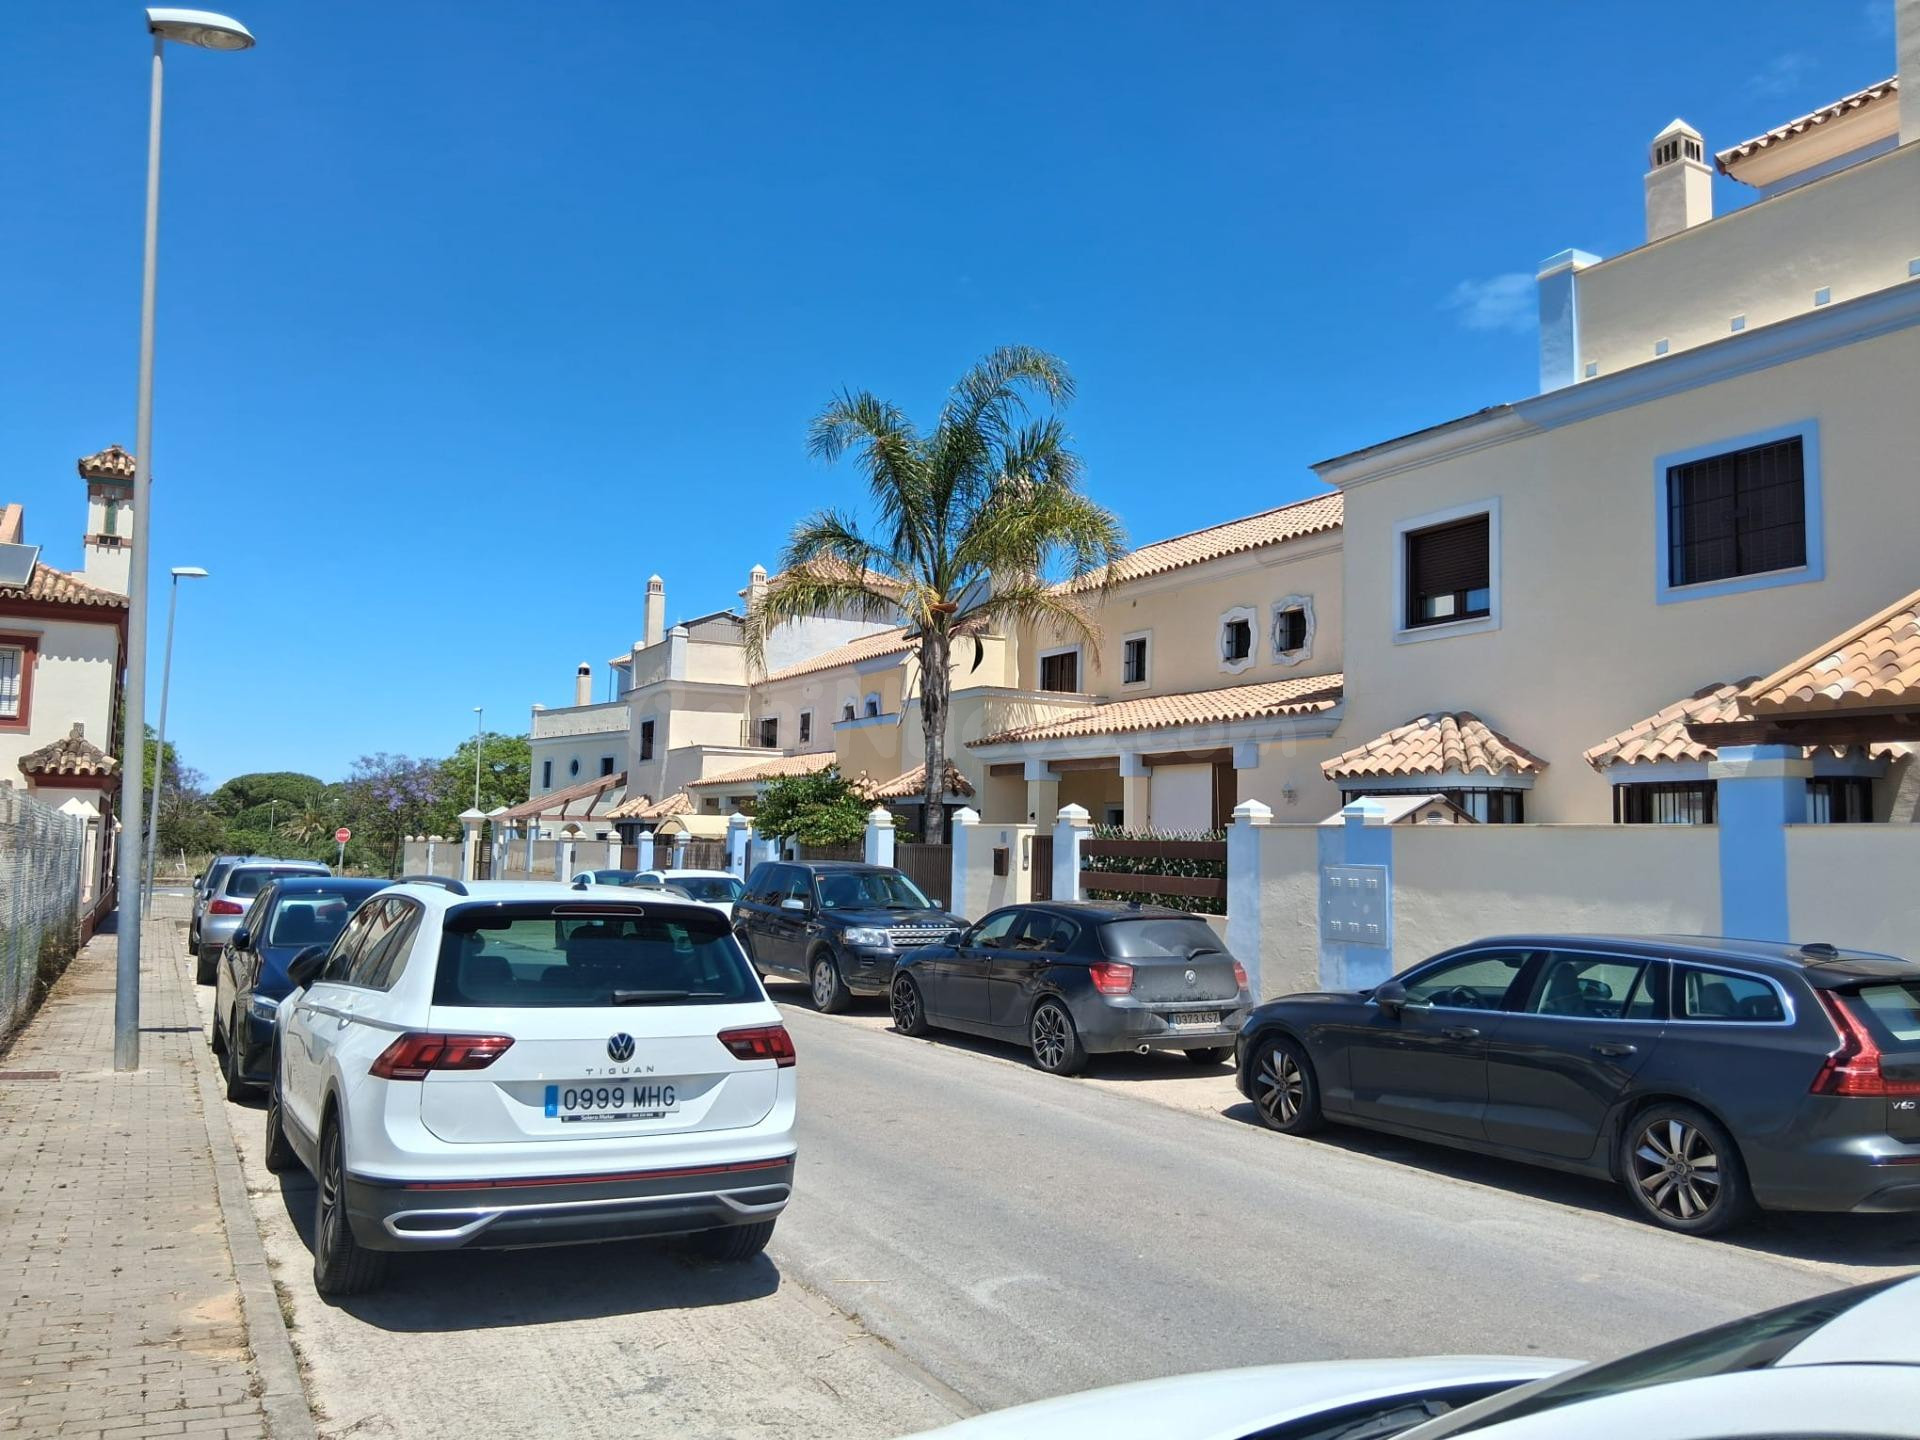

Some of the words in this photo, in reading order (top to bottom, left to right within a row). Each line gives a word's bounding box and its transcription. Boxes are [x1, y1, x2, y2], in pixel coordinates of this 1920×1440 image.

[1175, 1013, 1199, 1024] 0373
[585, 1065, 654, 1075] TIGUAN
[564, 1088, 625, 1111] 0999
[633, 1085, 675, 1108] MHG
[1892, 1101, 1916, 1109] V60
